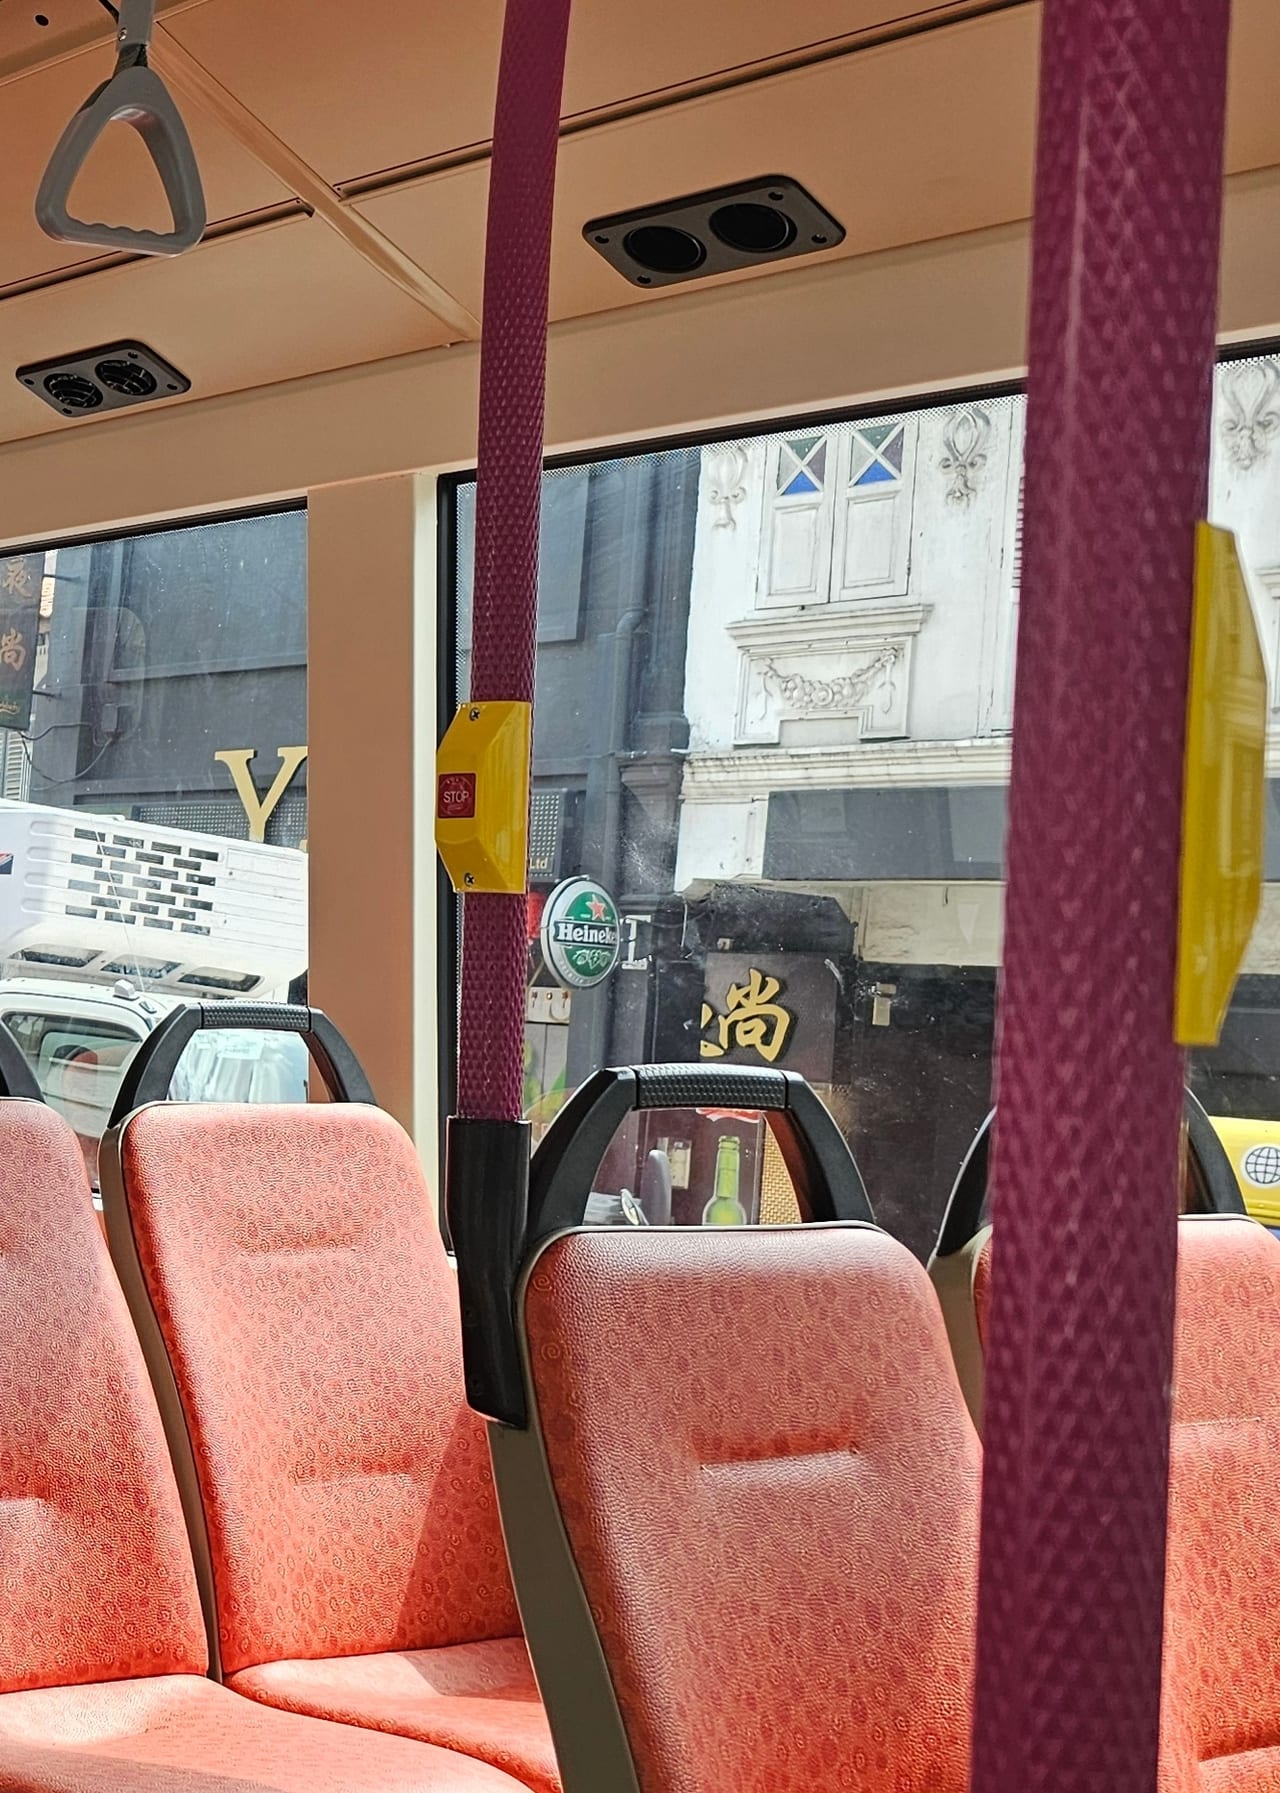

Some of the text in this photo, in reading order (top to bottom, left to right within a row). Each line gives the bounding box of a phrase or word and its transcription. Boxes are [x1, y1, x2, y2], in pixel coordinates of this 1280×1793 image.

[443, 790, 470, 803] STOP
[529, 856, 549, 870] Ltd
[700, 967, 791, 1062] 尚
